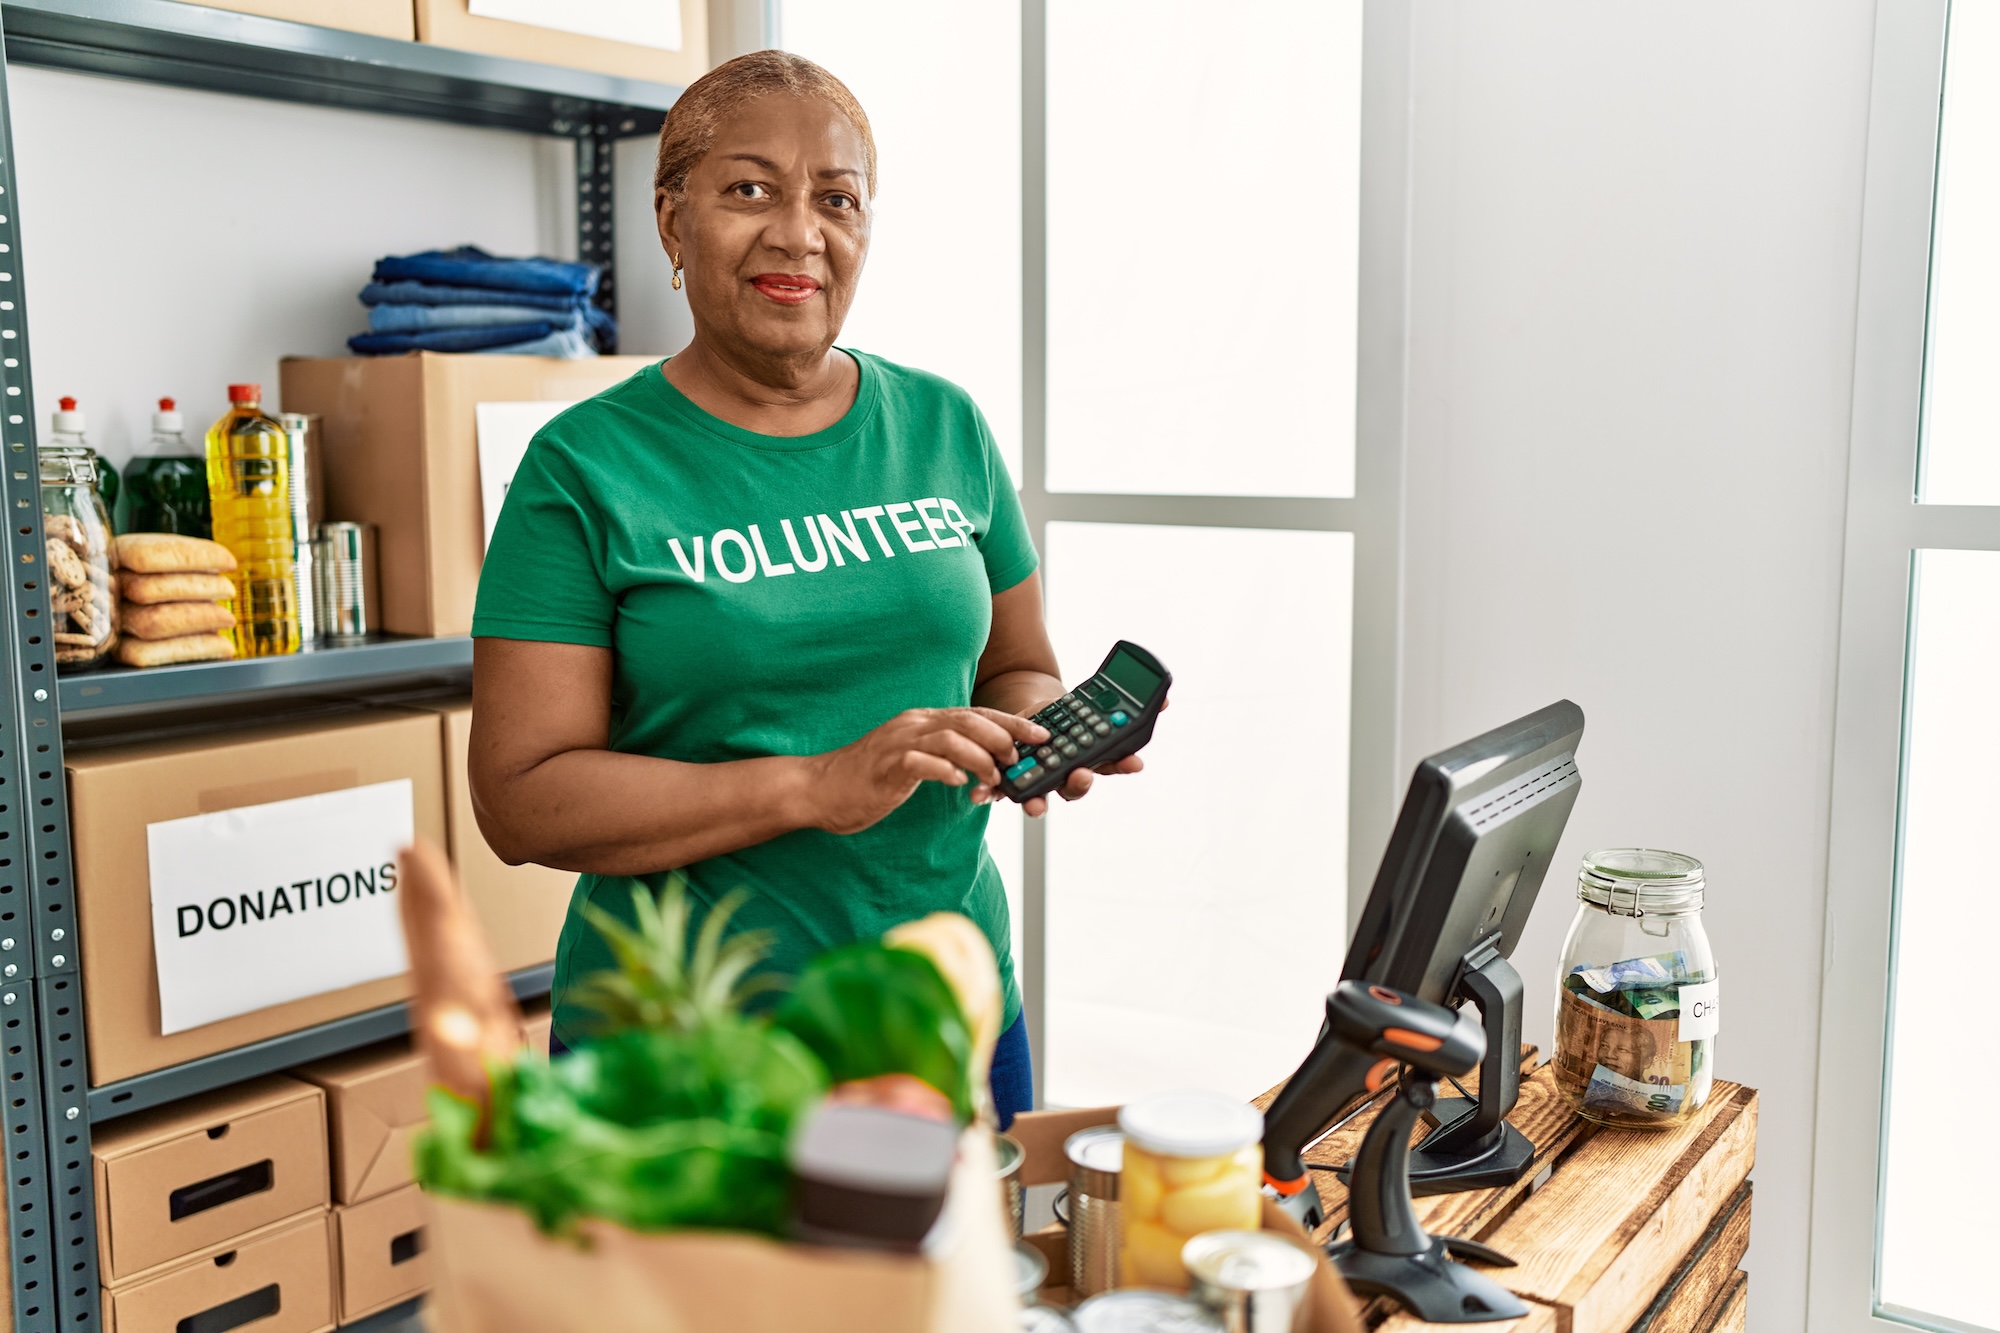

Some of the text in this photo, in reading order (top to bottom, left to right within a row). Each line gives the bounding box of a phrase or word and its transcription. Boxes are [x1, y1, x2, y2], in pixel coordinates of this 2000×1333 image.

[667, 497, 975, 583] VOLUNTEER
[176, 862, 398, 938] DONATIONS
[1645, 1093, 1671, 1113] 100
